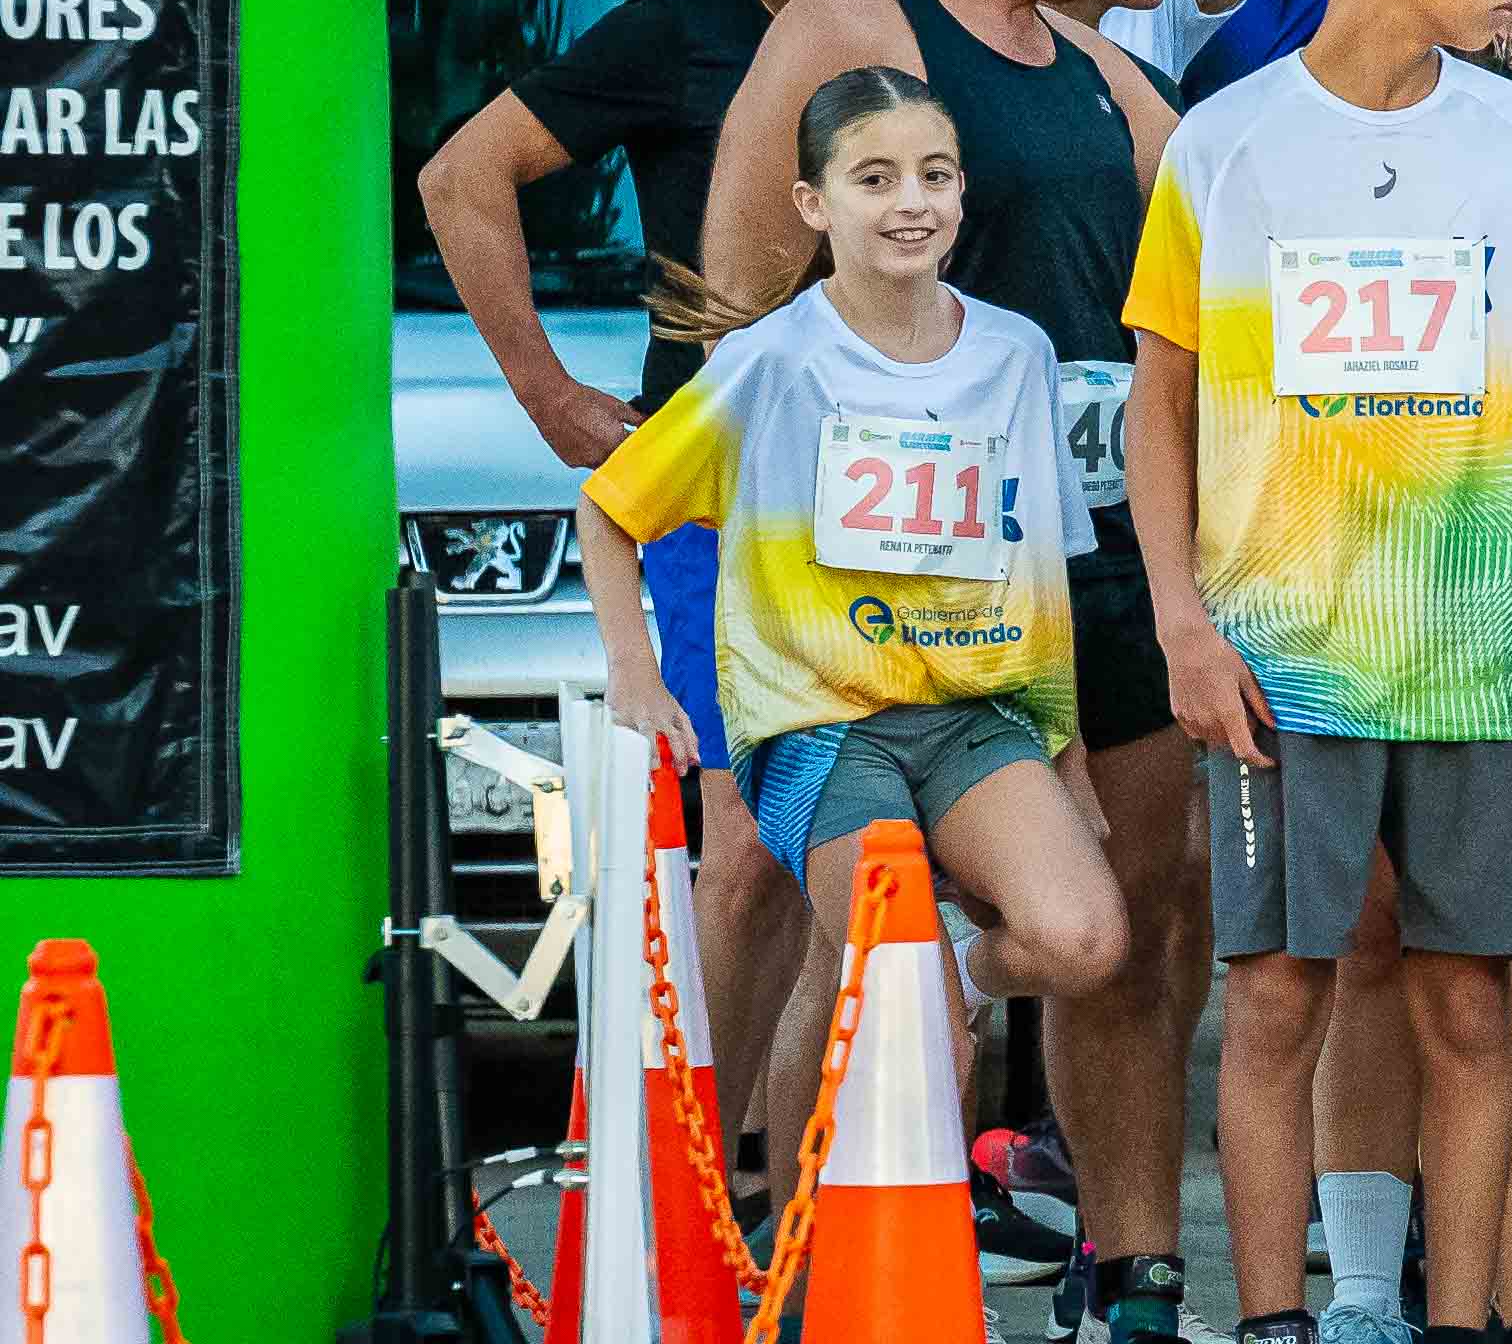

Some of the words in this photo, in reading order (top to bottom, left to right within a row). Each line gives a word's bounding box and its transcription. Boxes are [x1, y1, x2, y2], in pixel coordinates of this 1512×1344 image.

[104, 88, 201, 156] LAS
[43, 202, 151, 271] LOS
[1298, 280, 1457, 353] 217
[1354, 396, 1484, 418] Elortondo
[840, 456, 985, 539] 211
[1239, 778, 1251, 805] NIKE
